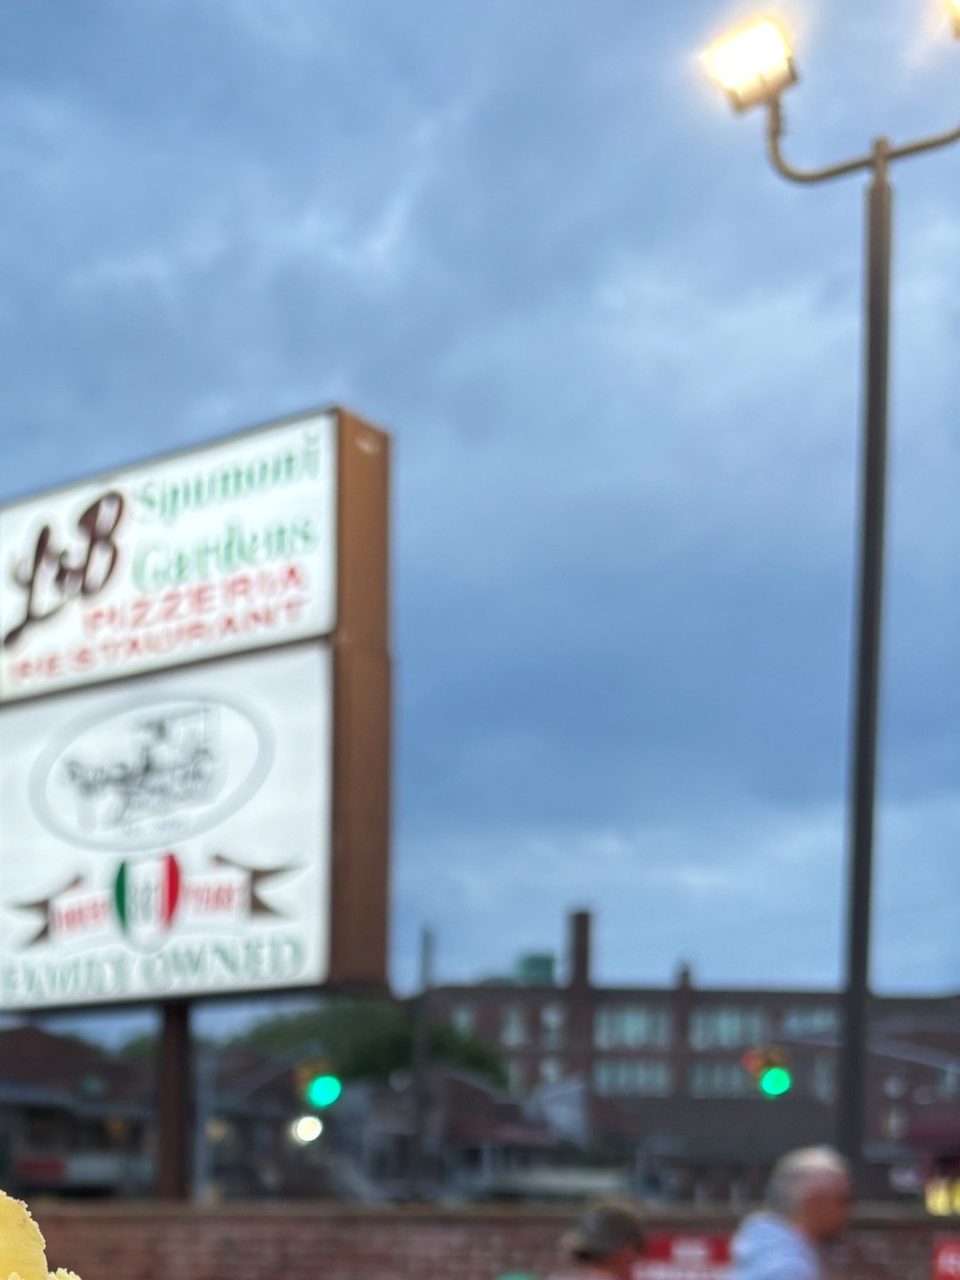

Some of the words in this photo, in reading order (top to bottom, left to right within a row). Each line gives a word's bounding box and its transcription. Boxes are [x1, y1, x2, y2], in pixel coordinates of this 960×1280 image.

[131, 519, 316, 593] Gardens
[85, 563, 303, 634] PIZZERIA
[11, 599, 306, 682] RESTAURANT
[0, 948, 127, 996] FAMILY
[139, 935, 306, 991] OWNED
